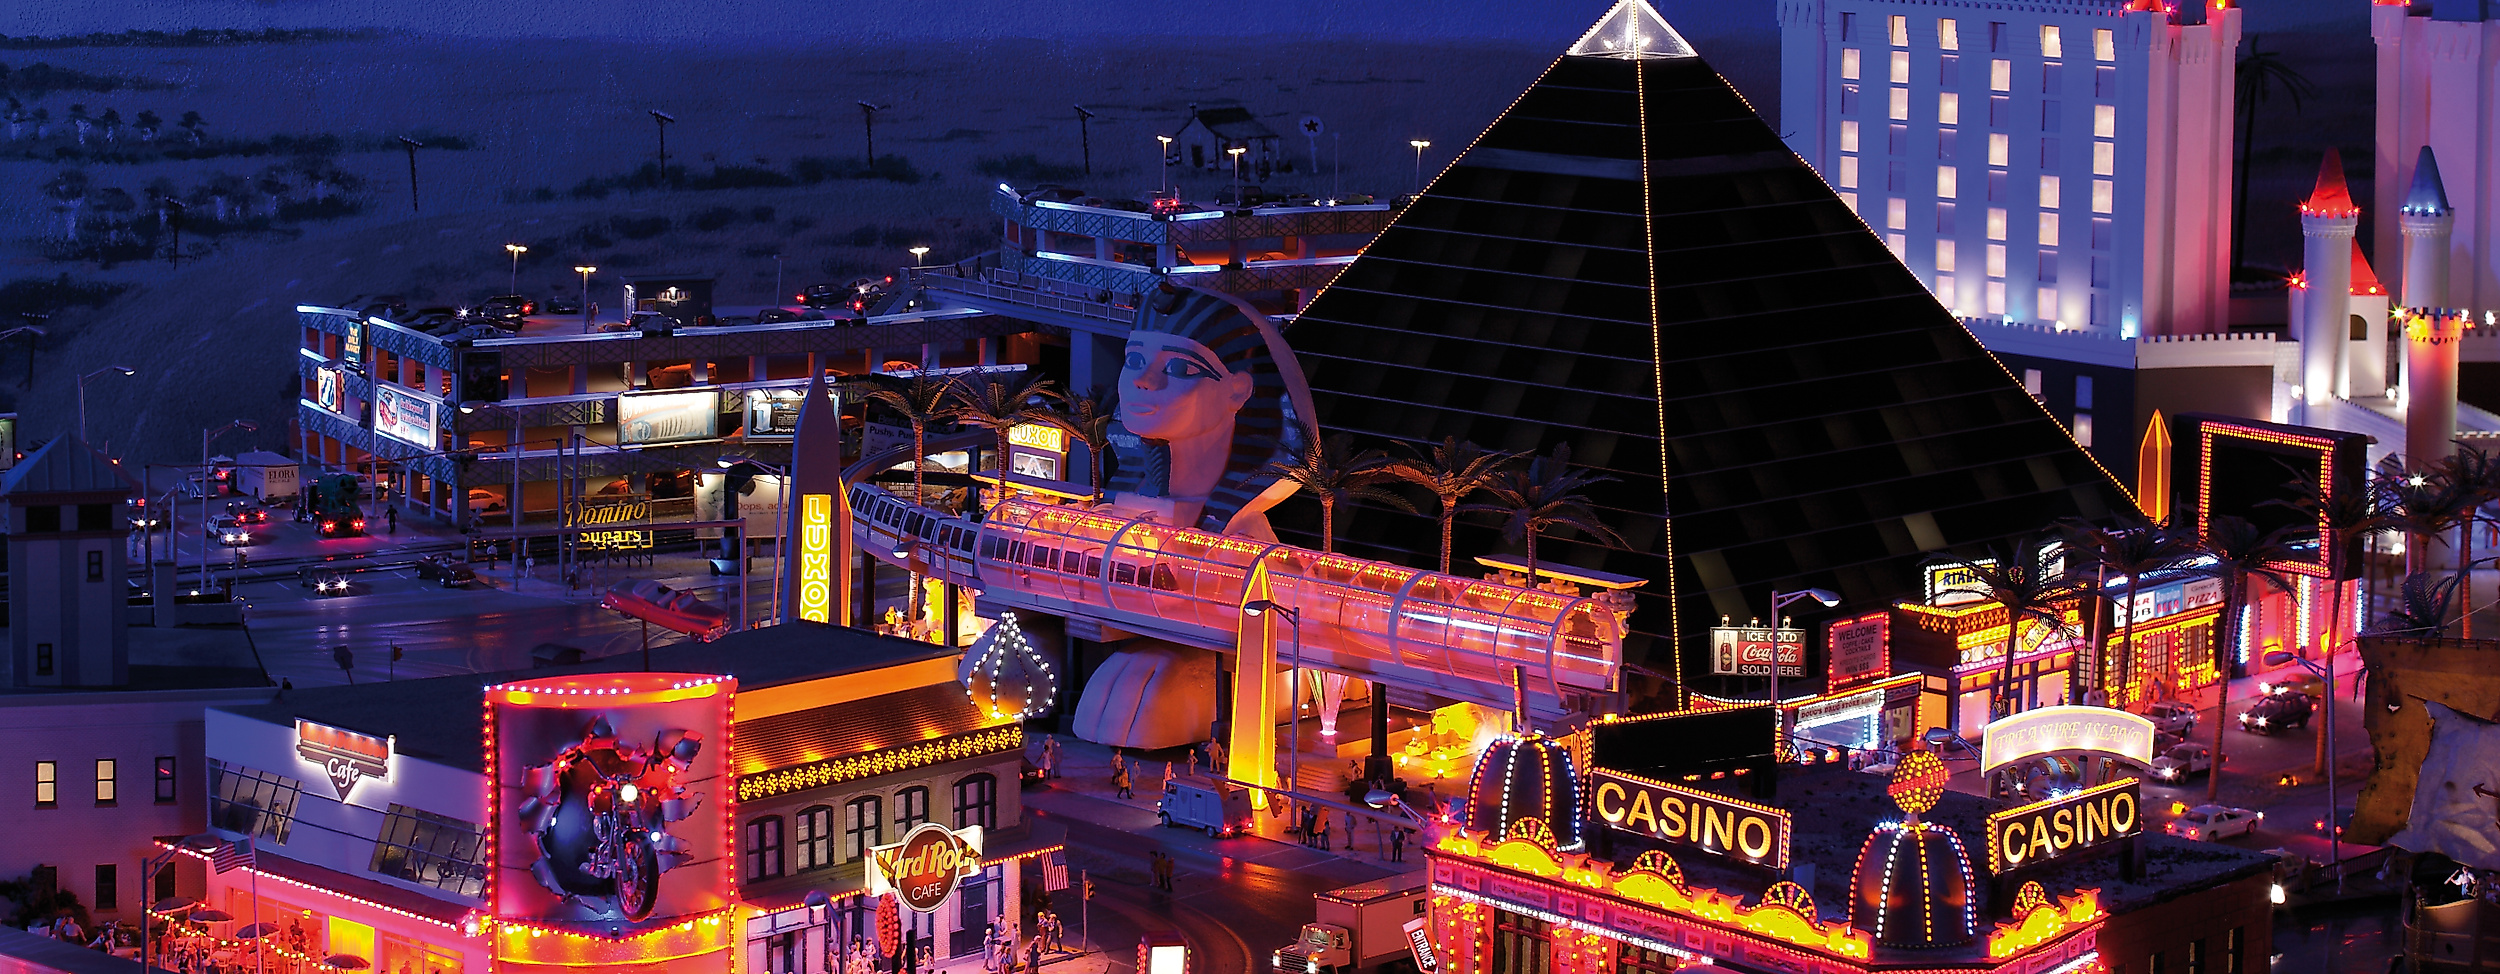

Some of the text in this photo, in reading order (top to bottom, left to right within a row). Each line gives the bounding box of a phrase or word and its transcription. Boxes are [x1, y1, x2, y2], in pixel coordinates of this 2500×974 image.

[1010, 425, 1061, 448] LUXOR
[565, 500, 646, 527] Domino
[2157, 599, 2180, 614] BEER
[2187, 591, 2217, 605] PIZZA
[1747, 632, 1797, 642] ICE COLD
[1839, 625, 1877, 641] WELCOME
[1742, 665, 1770, 675] SOLD
[1824, 705, 1840, 713] DRUG
[1841, 700, 1859, 709] STORE
[1994, 721, 2144, 754] TREASURE ISLAND
[327, 758, 360, 788] Cafe
[1596, 782, 1772, 858] CASINO
[2003, 792, 2135, 864] CASINO
[911, 882, 941, 901] CAFE
[1411, 928, 1437, 969] ENTRANCE
